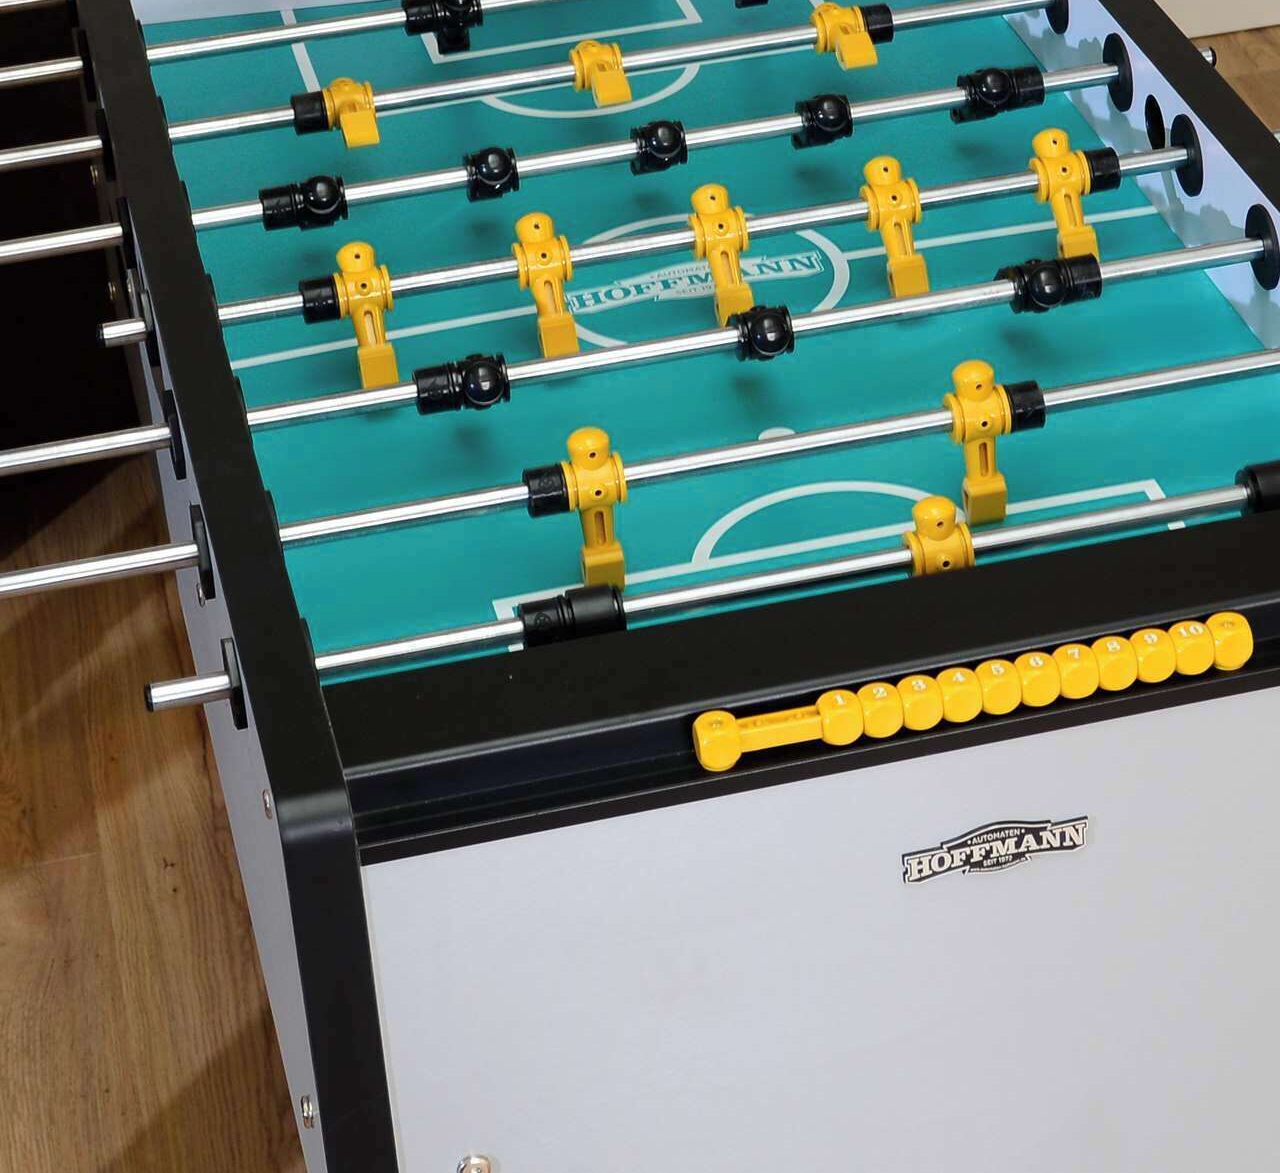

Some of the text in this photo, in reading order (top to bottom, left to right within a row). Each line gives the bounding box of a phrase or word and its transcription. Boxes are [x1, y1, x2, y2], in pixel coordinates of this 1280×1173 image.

[572, 254, 819, 309] HOFFMNN
[834, 624, 1205, 705] 1 2 3 4 5 6 7 8 9 10
[907, 823, 1088, 881] HOFFMANN
[971, 828, 1021, 845] AUTOMATEN
[982, 857, 998, 867] SEIT
